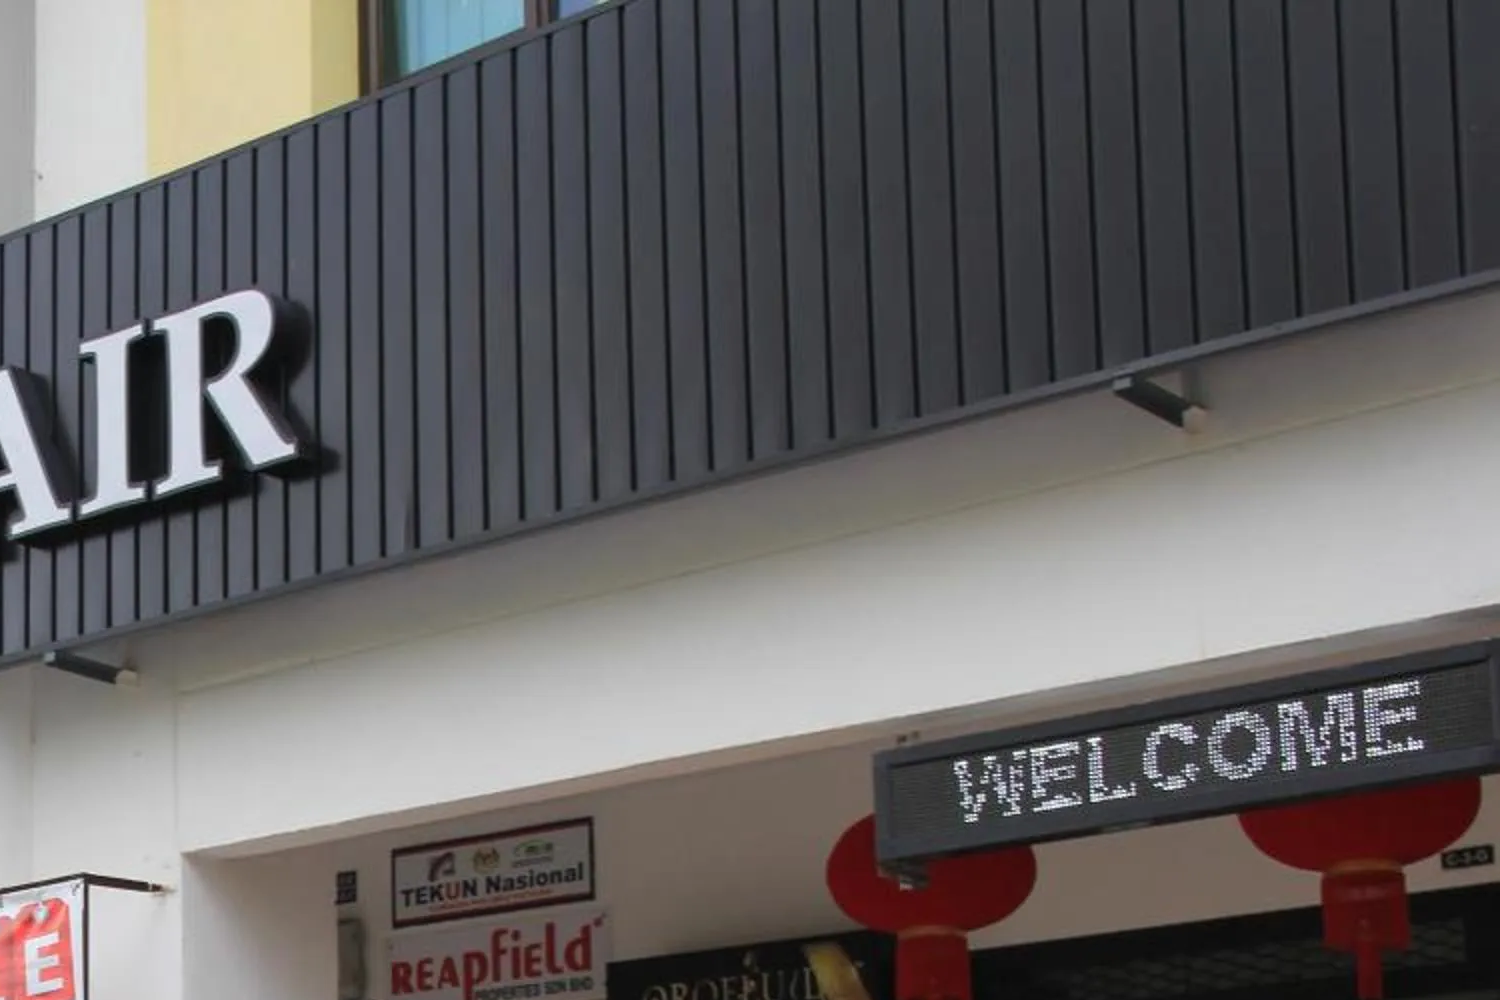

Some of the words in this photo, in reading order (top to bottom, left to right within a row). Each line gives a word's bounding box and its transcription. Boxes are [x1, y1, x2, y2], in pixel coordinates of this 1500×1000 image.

[952, 678, 1425, 824] WELCOME
[400, 878, 478, 909] TEKUN
[485, 861, 584, 897] Nasional
